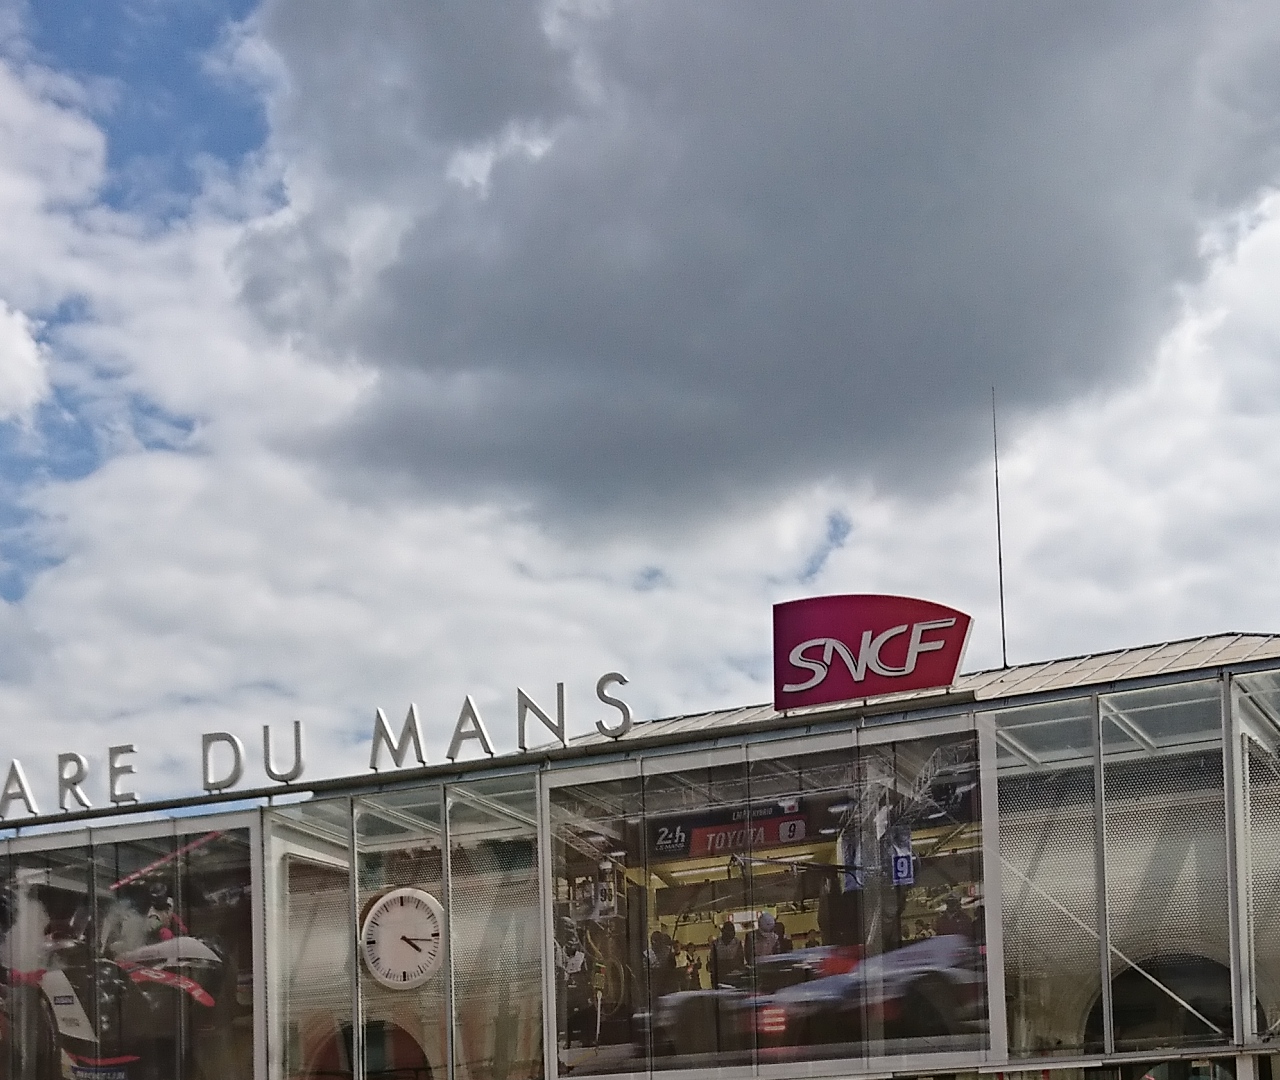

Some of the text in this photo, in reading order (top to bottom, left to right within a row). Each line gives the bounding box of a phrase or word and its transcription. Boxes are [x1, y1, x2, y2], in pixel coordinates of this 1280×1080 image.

[782, 617, 957, 693] SNCF
[202, 720, 305, 792] DU
[369, 671, 634, 769] MANS
[706, 826, 766, 851] TOYOTA
[787, 823, 797, 839] 9
[896, 857, 909, 878] 9
